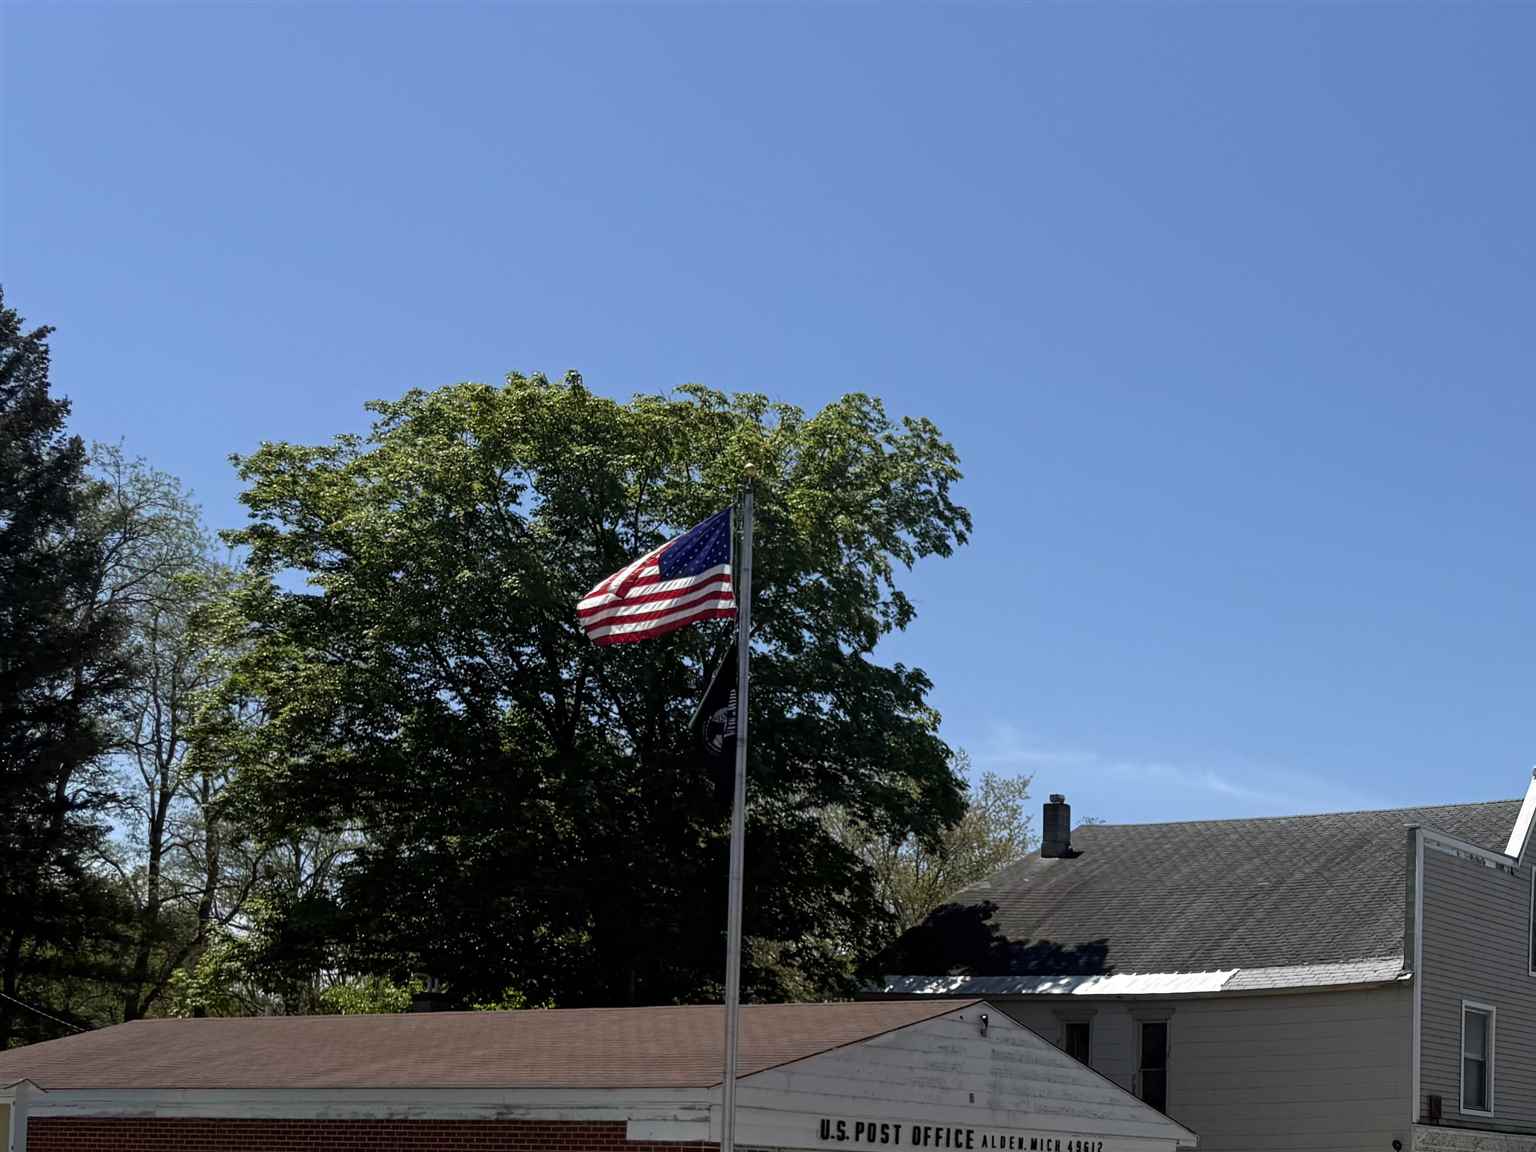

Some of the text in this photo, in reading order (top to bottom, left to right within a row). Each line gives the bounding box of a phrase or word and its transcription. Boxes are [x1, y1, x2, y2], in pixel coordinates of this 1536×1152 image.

[820, 1118, 850, 1141] U.S.
[855, 1121, 902, 1145] POST
[912, 1125, 975, 1150] OFFICE
